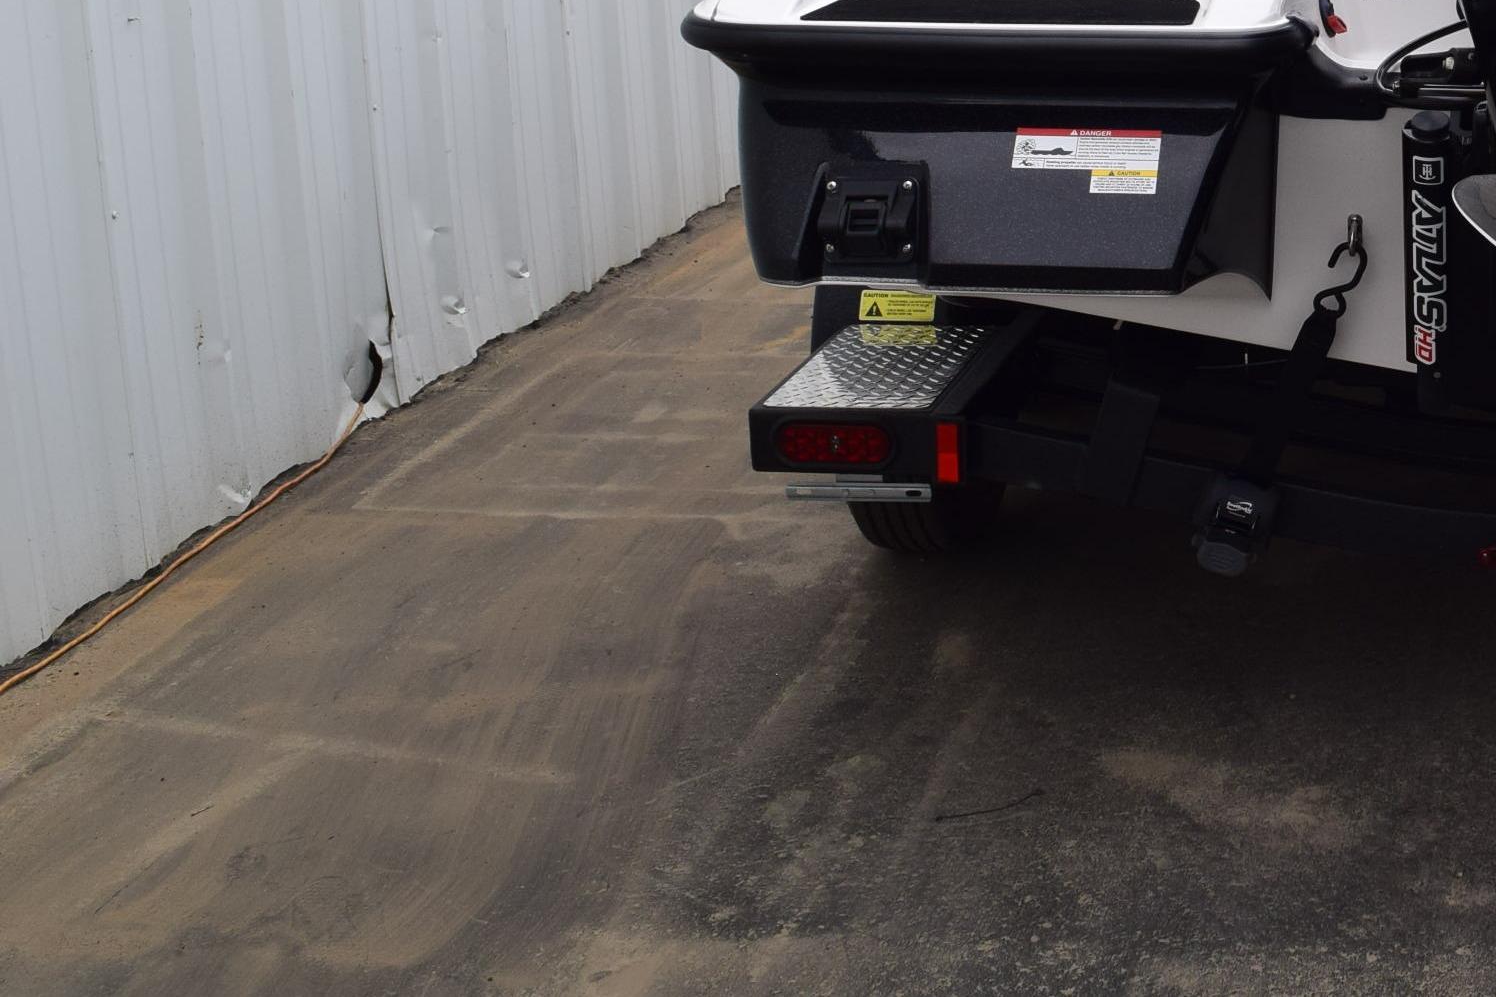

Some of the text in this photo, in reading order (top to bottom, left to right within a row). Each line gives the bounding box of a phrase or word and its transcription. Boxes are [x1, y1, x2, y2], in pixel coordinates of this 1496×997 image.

[1079, 129, 1112, 137] DANGER
[1411, 189, 1448, 366] ATLAS HD
